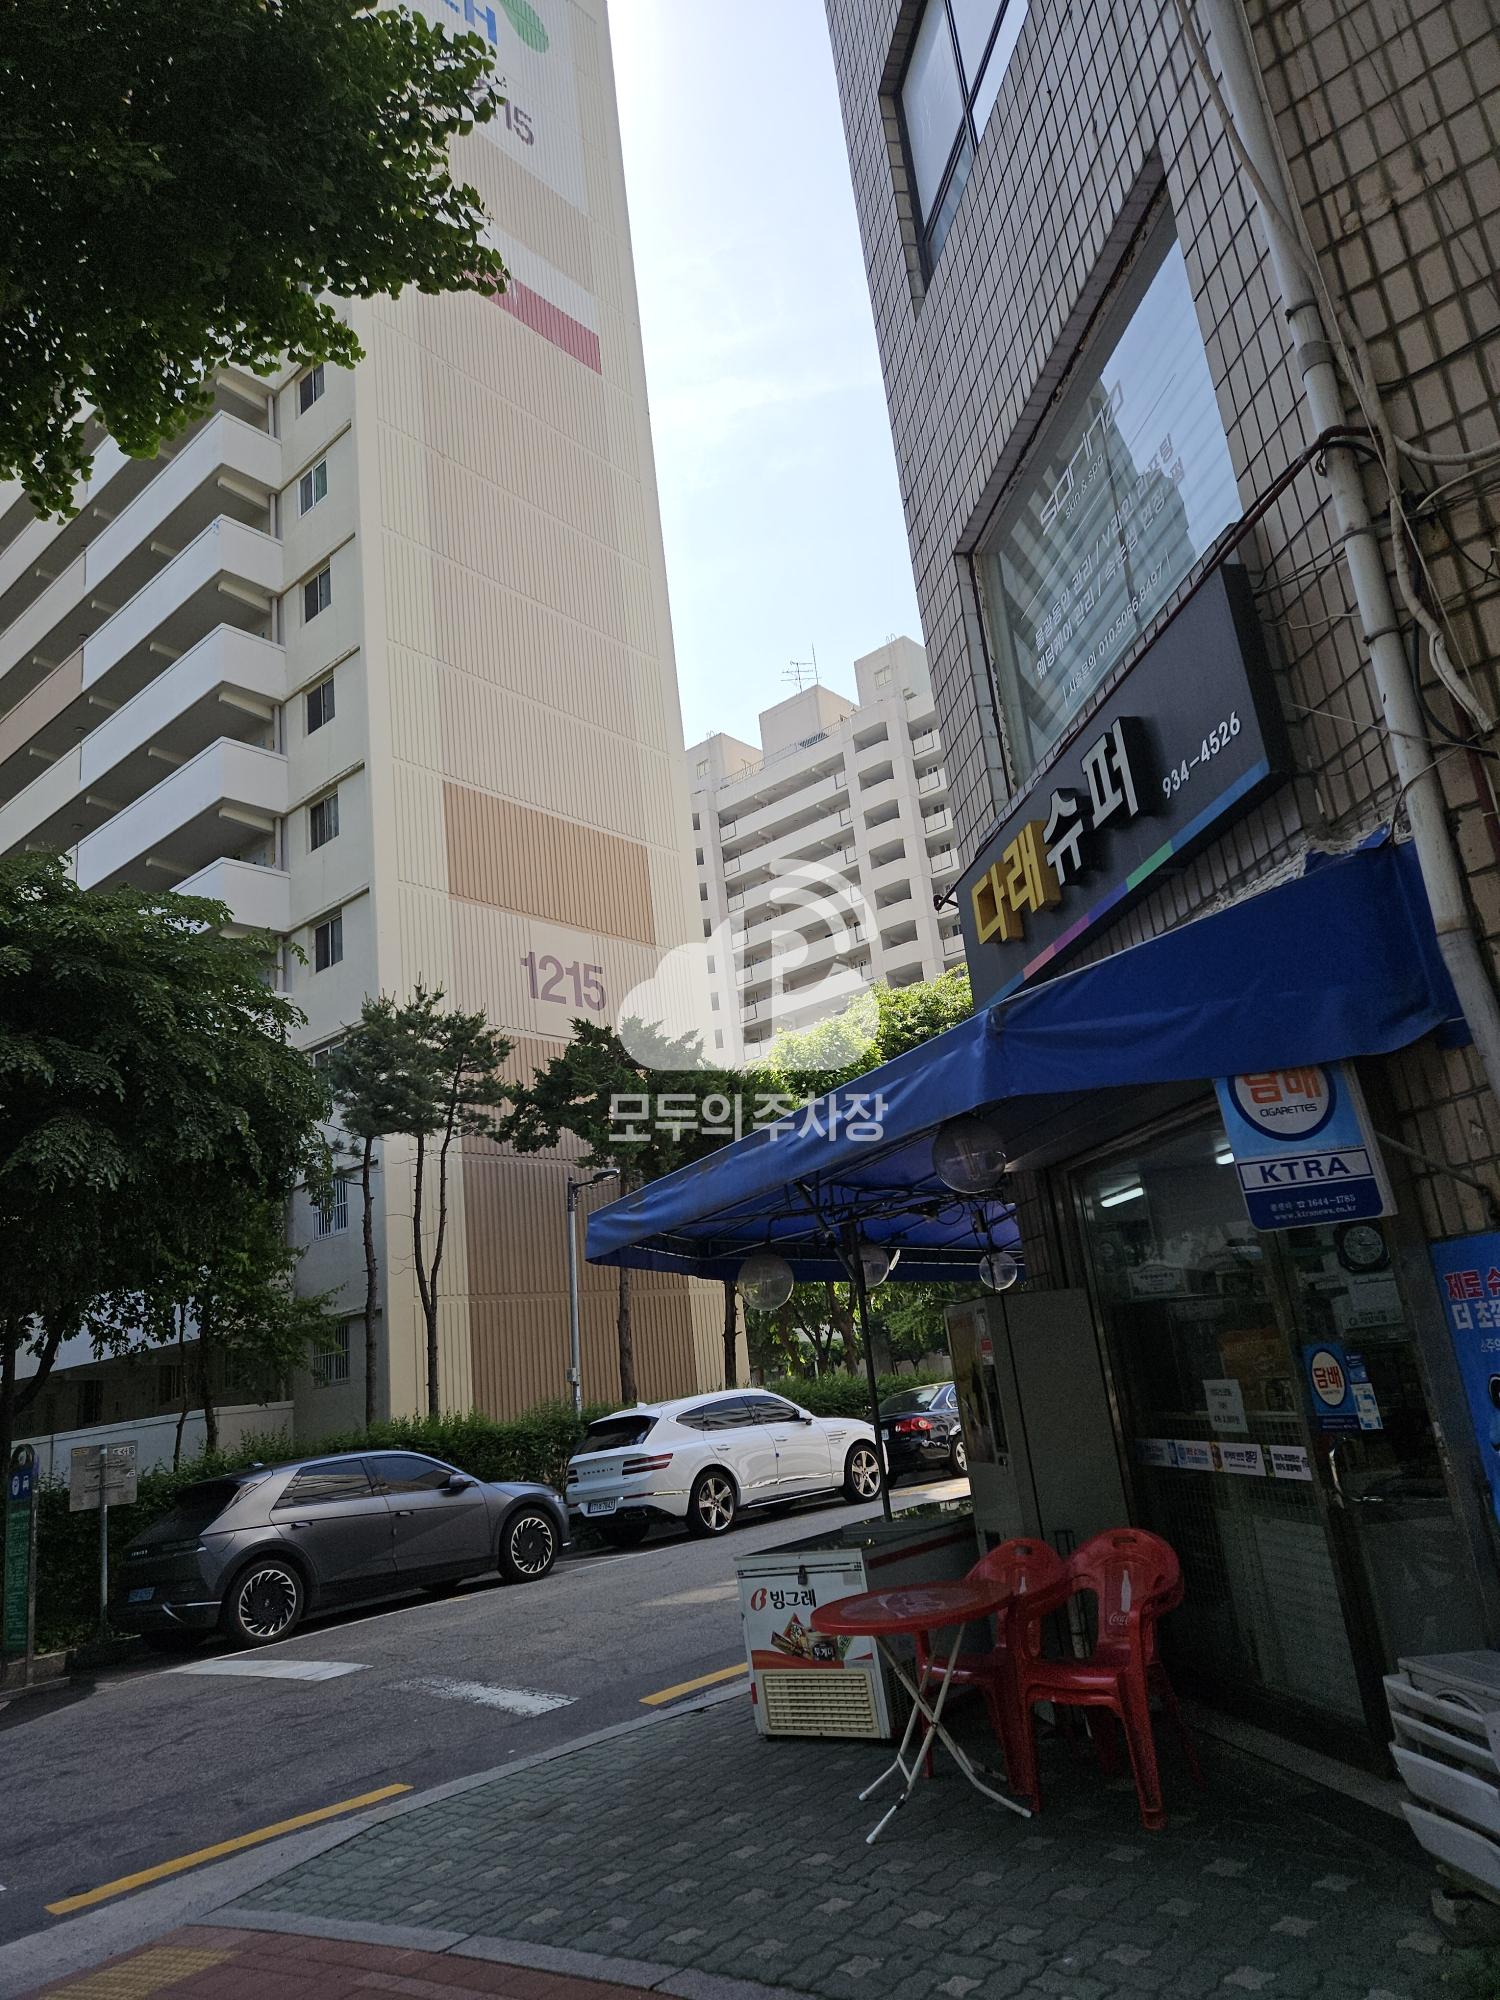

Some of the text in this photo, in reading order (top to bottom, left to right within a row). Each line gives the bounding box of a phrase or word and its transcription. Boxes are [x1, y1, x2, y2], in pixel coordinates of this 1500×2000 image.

[1162, 710, 1242, 800] 934-4526
[520, 951, 607, 1012] 1215
[1259, 1156, 1351, 1184] KTRA
[1443, 1268, 1484, 1301] 제로
[1451, 1301, 1474, 1330] 더
[1313, 1366, 1343, 1389] 담배
[769, 1588, 817, 1610] 빙그레
